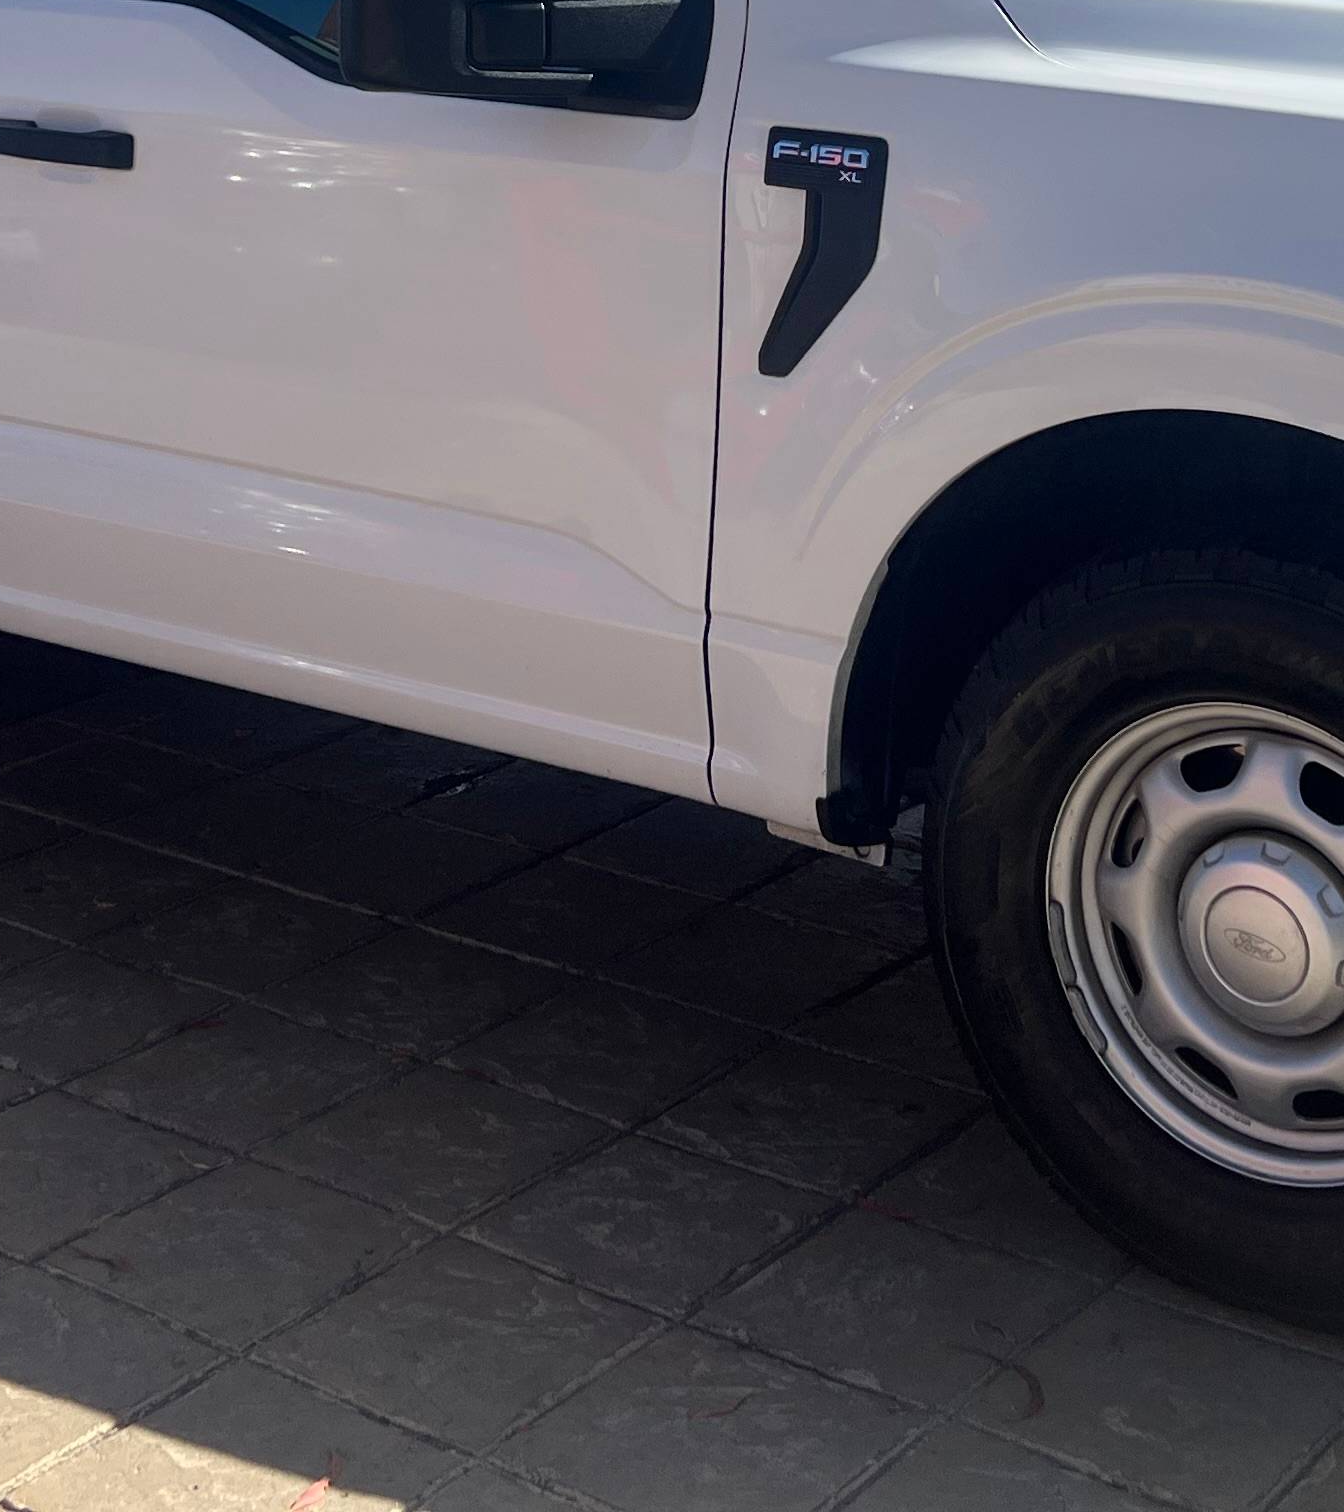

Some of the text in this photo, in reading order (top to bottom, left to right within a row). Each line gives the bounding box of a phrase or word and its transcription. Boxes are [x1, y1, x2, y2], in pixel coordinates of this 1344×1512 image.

[772, 139, 870, 169] F-150
[838, 169, 862, 184] XL
[1233, 931, 1275, 961] Ford
